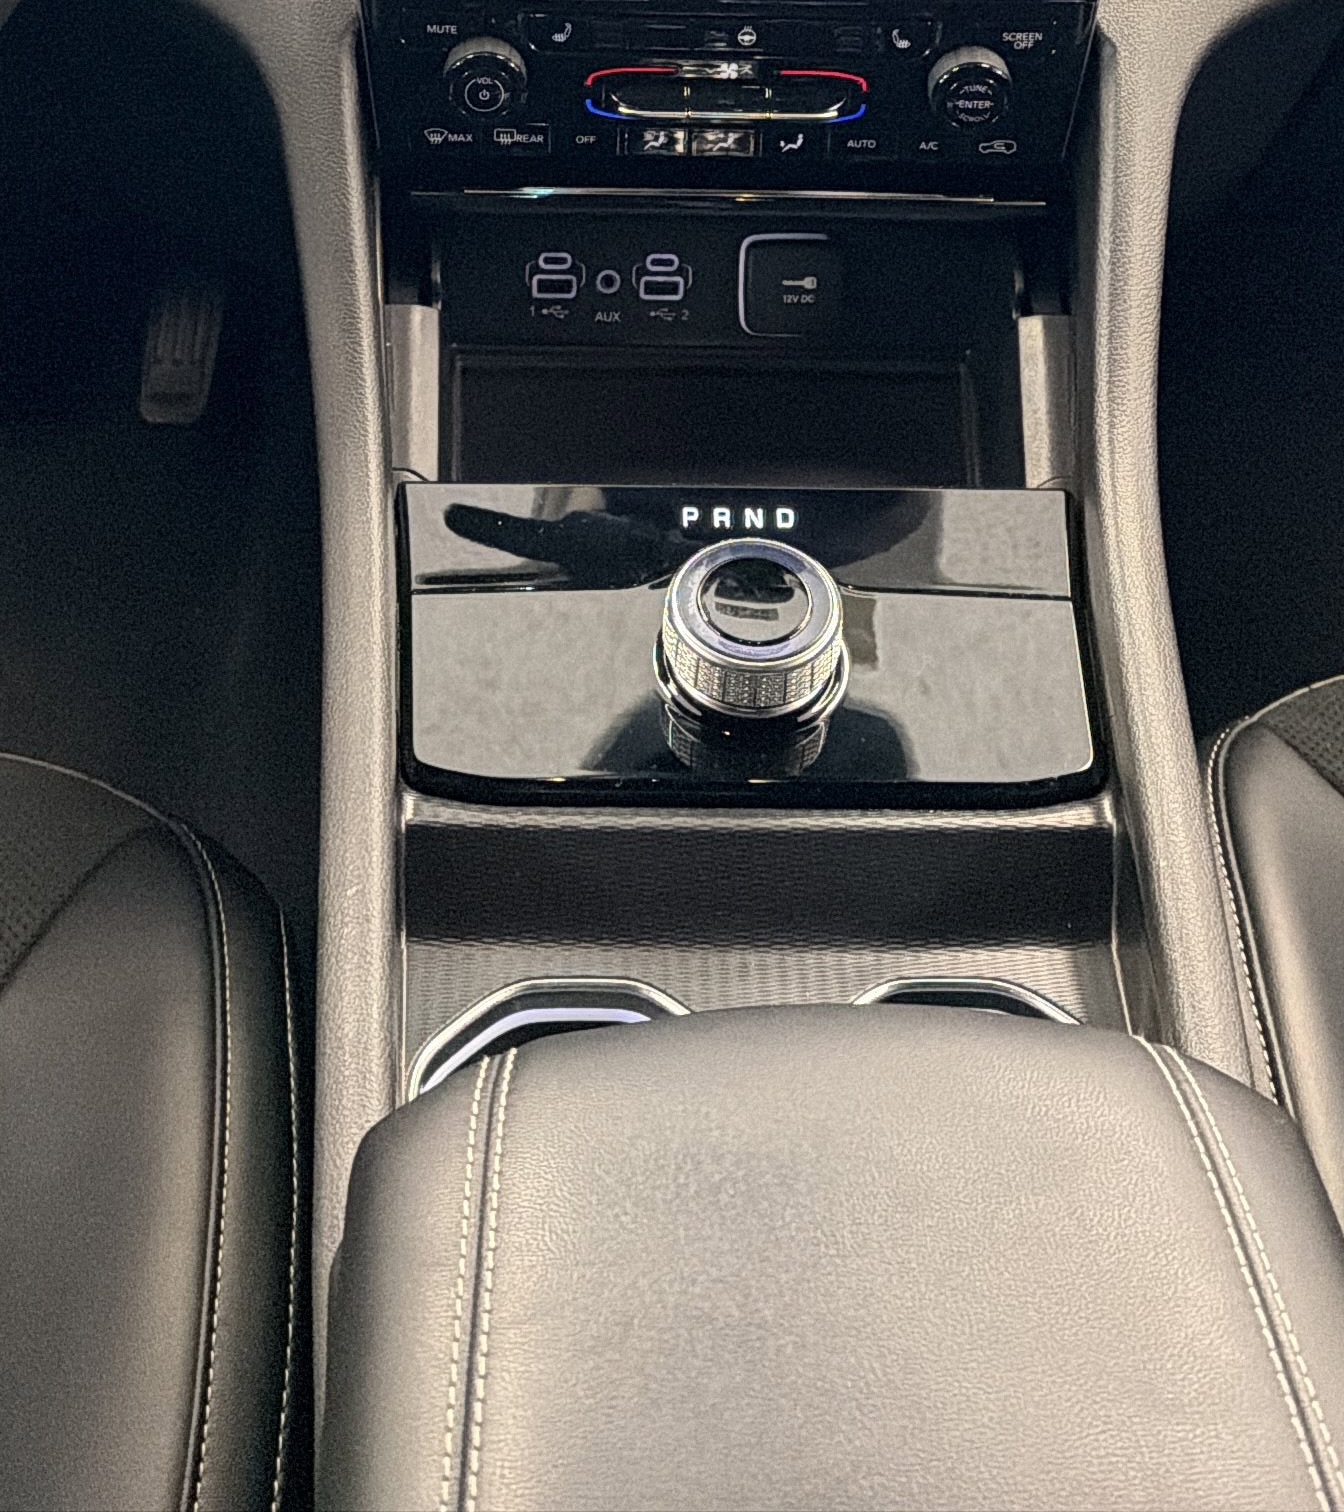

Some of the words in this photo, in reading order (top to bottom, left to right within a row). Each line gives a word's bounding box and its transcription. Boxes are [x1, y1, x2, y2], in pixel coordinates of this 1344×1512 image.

[426, 24, 458, 35] MUTE
[1002, 31, 1043, 42] SCREEN
[1013, 40, 1035, 50] OFF
[476, 76, 494, 85] VOL
[964, 83, 987, 94] TUNE
[958, 99, 992, 110] ENTER
[447, 133, 474, 143] MAX
[516, 133, 545, 144] REAR
[575, 135, 598, 144] OFF
[846, 139, 878, 149] AUTO
[918, 140, 939, 151] A/C
[782, 294, 800, 304] 12V
[594, 311, 622, 323] AUX
[681, 310, 690, 321] 2
